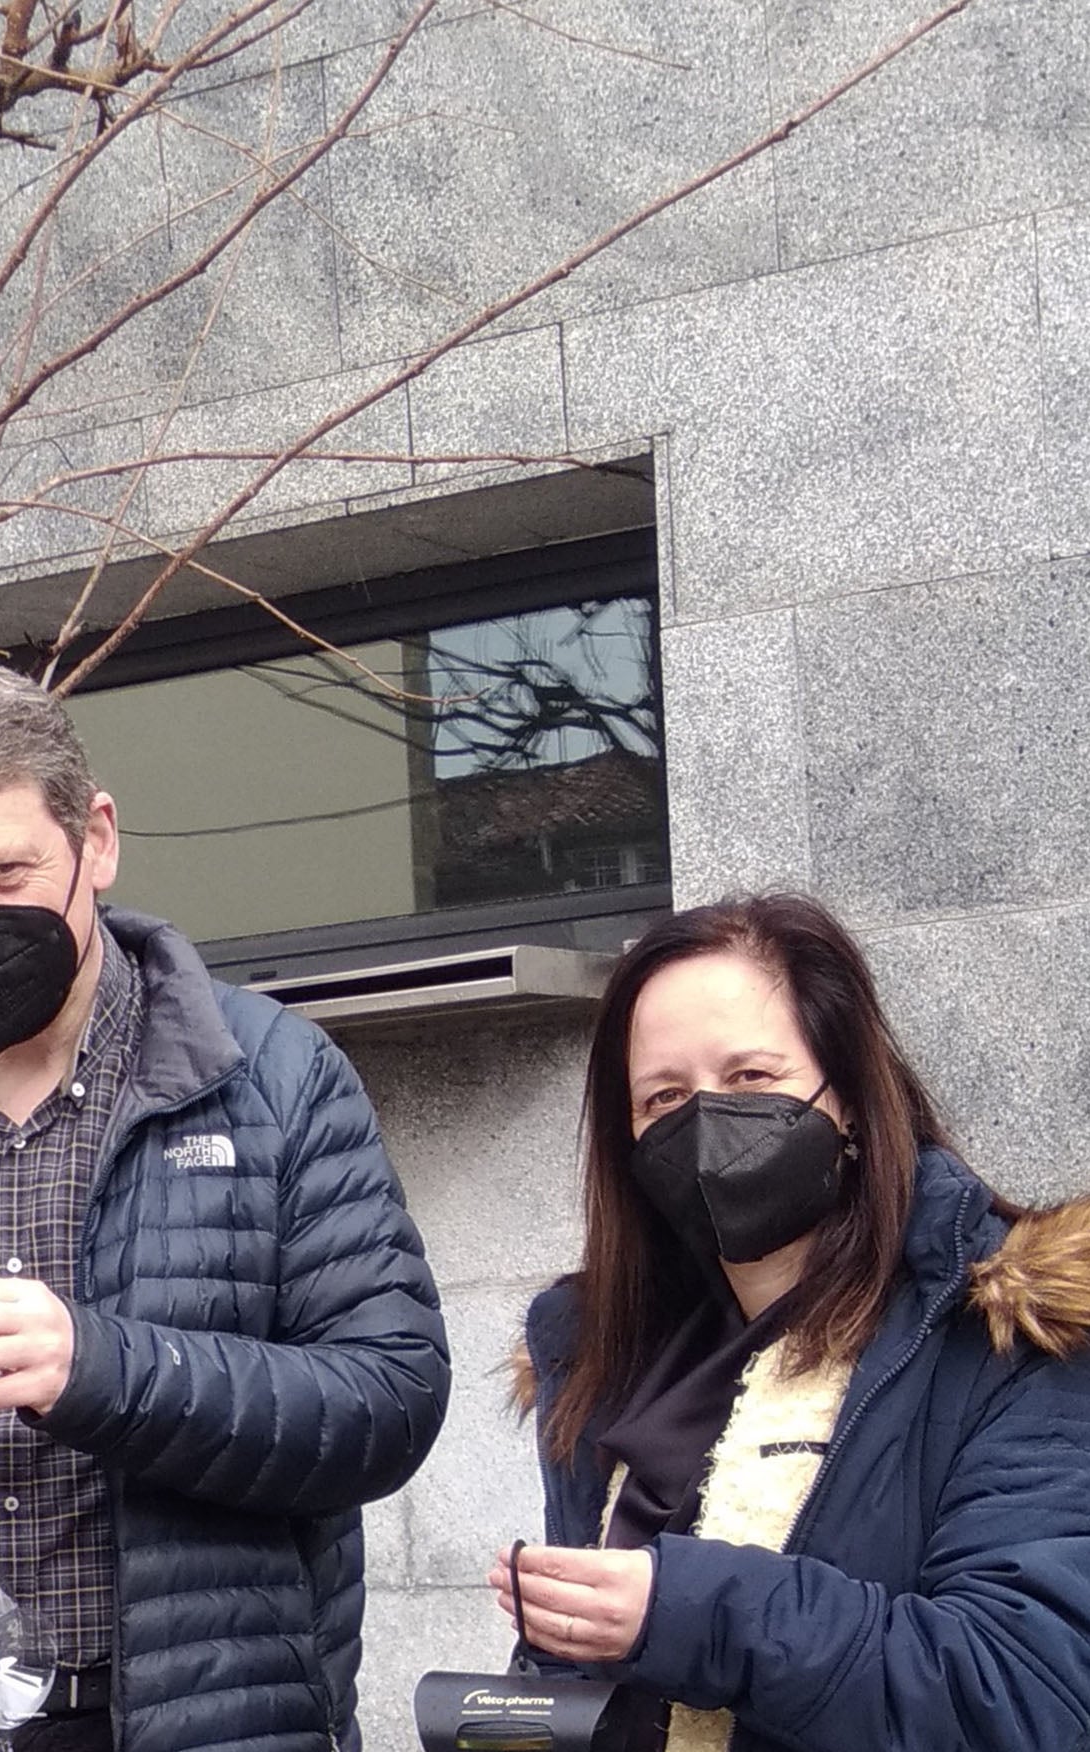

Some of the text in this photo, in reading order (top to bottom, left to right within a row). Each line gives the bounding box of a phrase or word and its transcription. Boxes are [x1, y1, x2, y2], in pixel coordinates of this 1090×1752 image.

[182, 1135, 211, 1147] THE
[163, 1145, 211, 1161] NORTH
[176, 1155, 211, 1169] FACE
